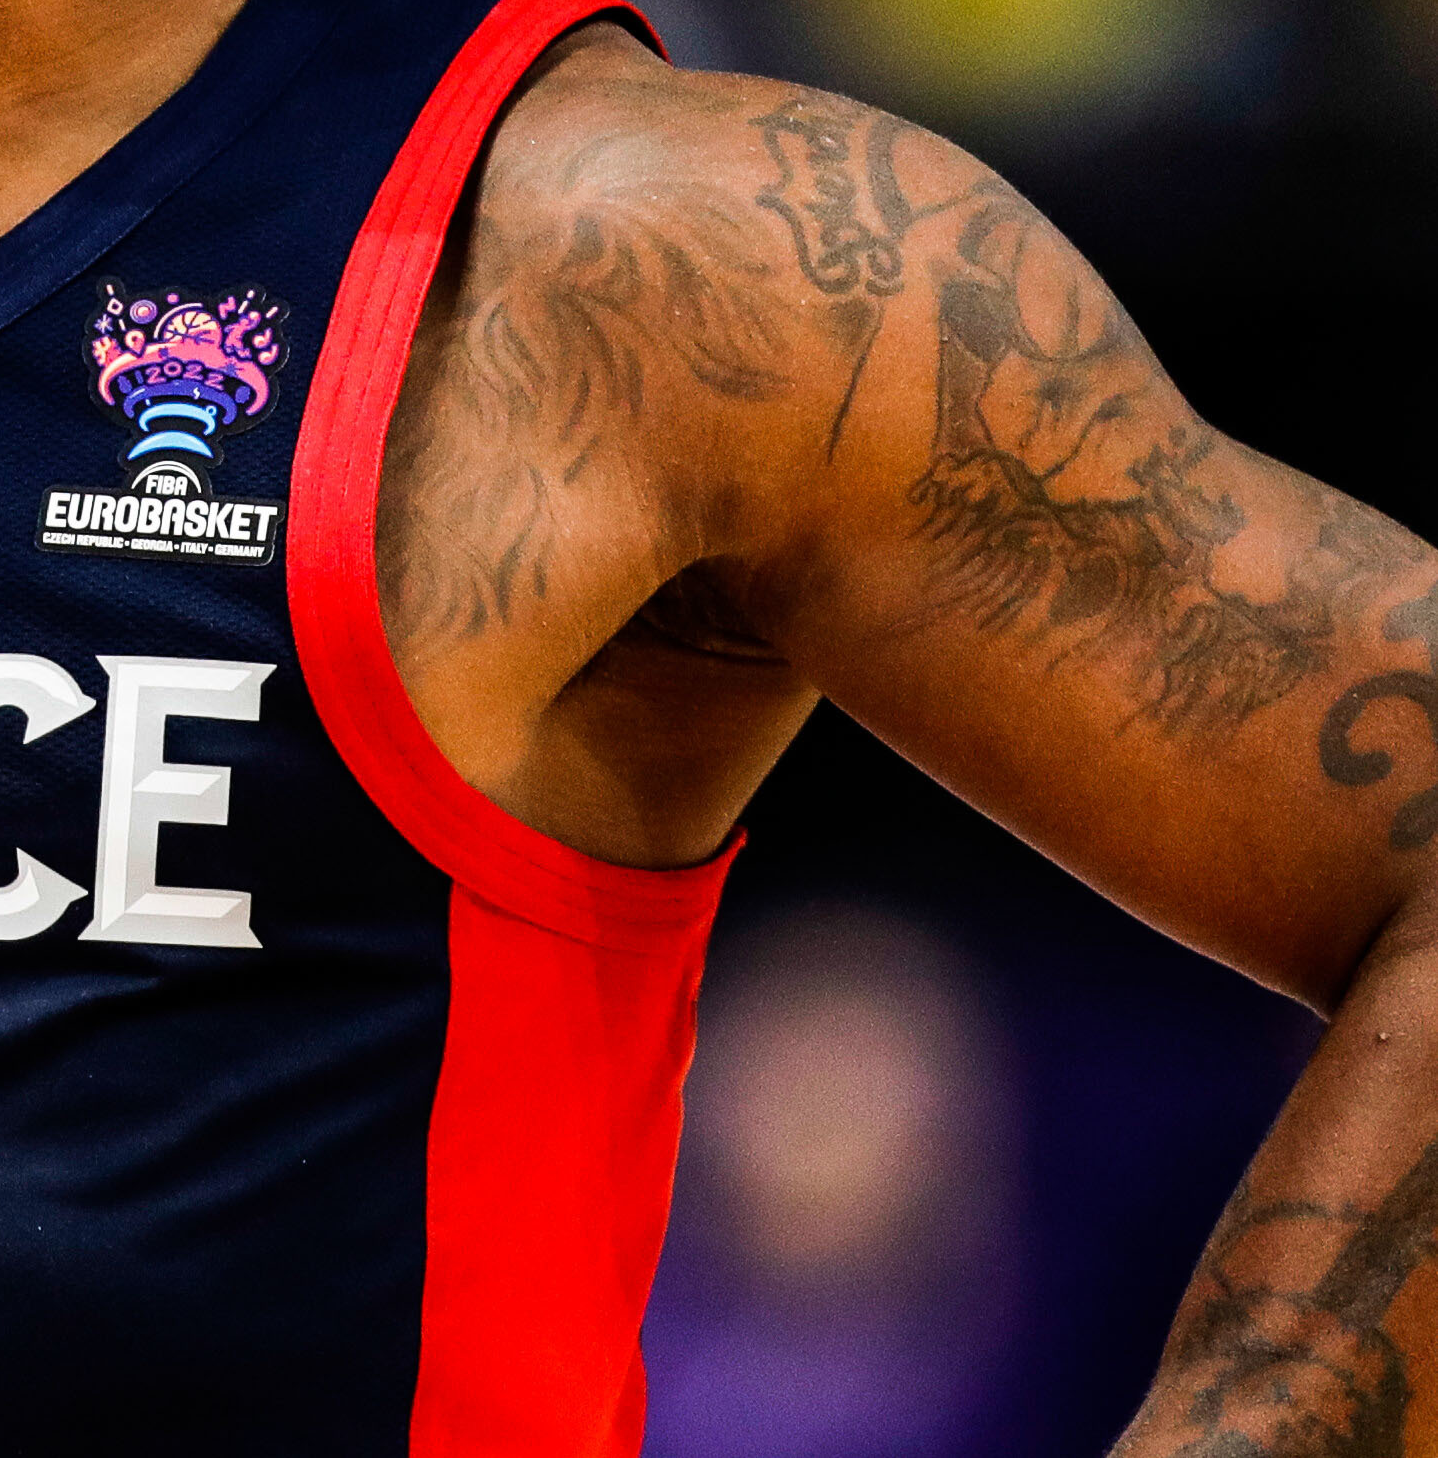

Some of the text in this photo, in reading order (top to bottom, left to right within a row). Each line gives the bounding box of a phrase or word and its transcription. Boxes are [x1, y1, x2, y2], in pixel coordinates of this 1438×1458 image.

[145, 361, 224, 391] 2022
[145, 474, 189, 496] FIBA
[45, 491, 278, 541] EUROBASKET
[42, 531, 266, 558] CZECH REPUBLIC GEORGIA ITALY GERMANY
